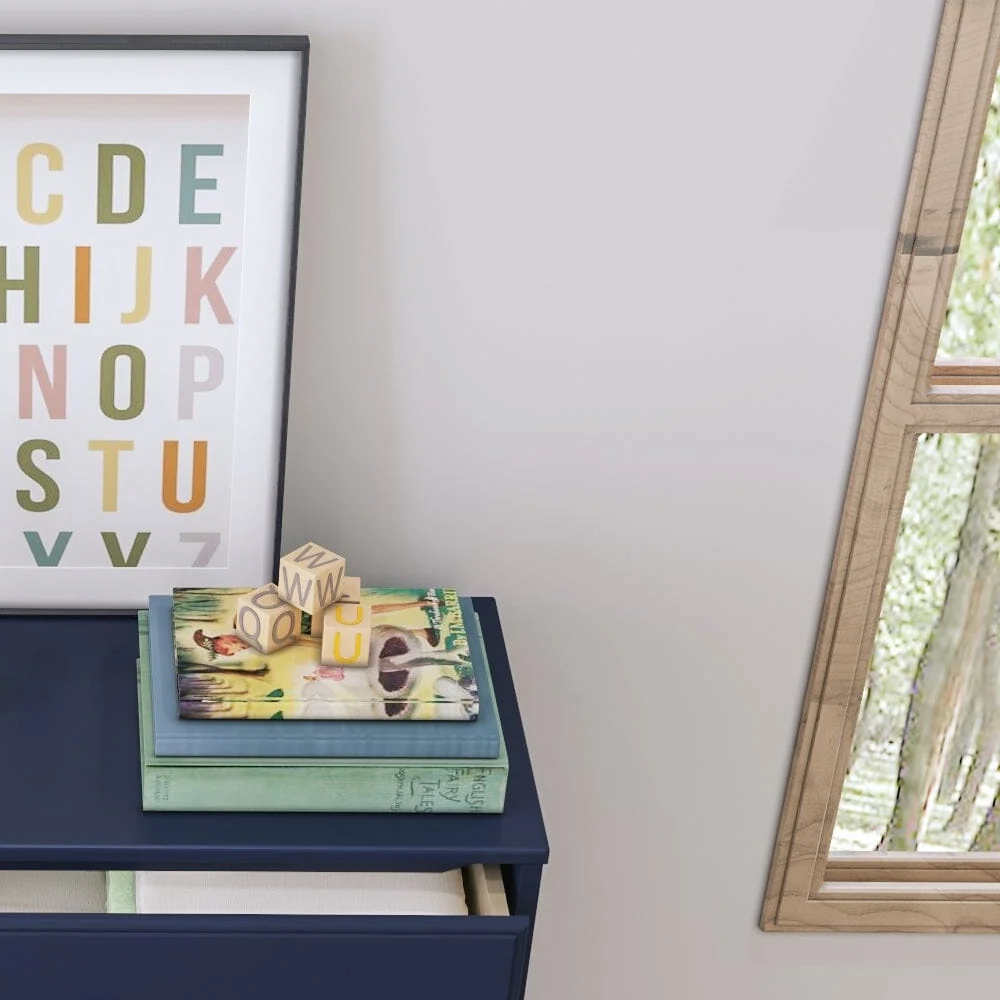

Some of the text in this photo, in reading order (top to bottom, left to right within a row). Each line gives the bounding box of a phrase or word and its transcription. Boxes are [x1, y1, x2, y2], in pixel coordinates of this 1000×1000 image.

[16, 142, 64, 225] C
[96, 143, 146, 225] D
[178, 143, 224, 225] E
[74, 246, 91, 324] I
[120, 246, 153, 324] J
[184, 246, 237, 325] K
[18, 344, 67, 420] N
[99, 344, 146, 421] O
[177, 345, 225, 420] P
[16, 439, 61, 513] S
[87, 440, 134, 512] T
[161, 440, 208, 514] U
[283, 566, 313, 608] W
[317, 566, 344, 608] W
[333, 632, 362, 664] U
[415, 779, 441, 812] TALES
